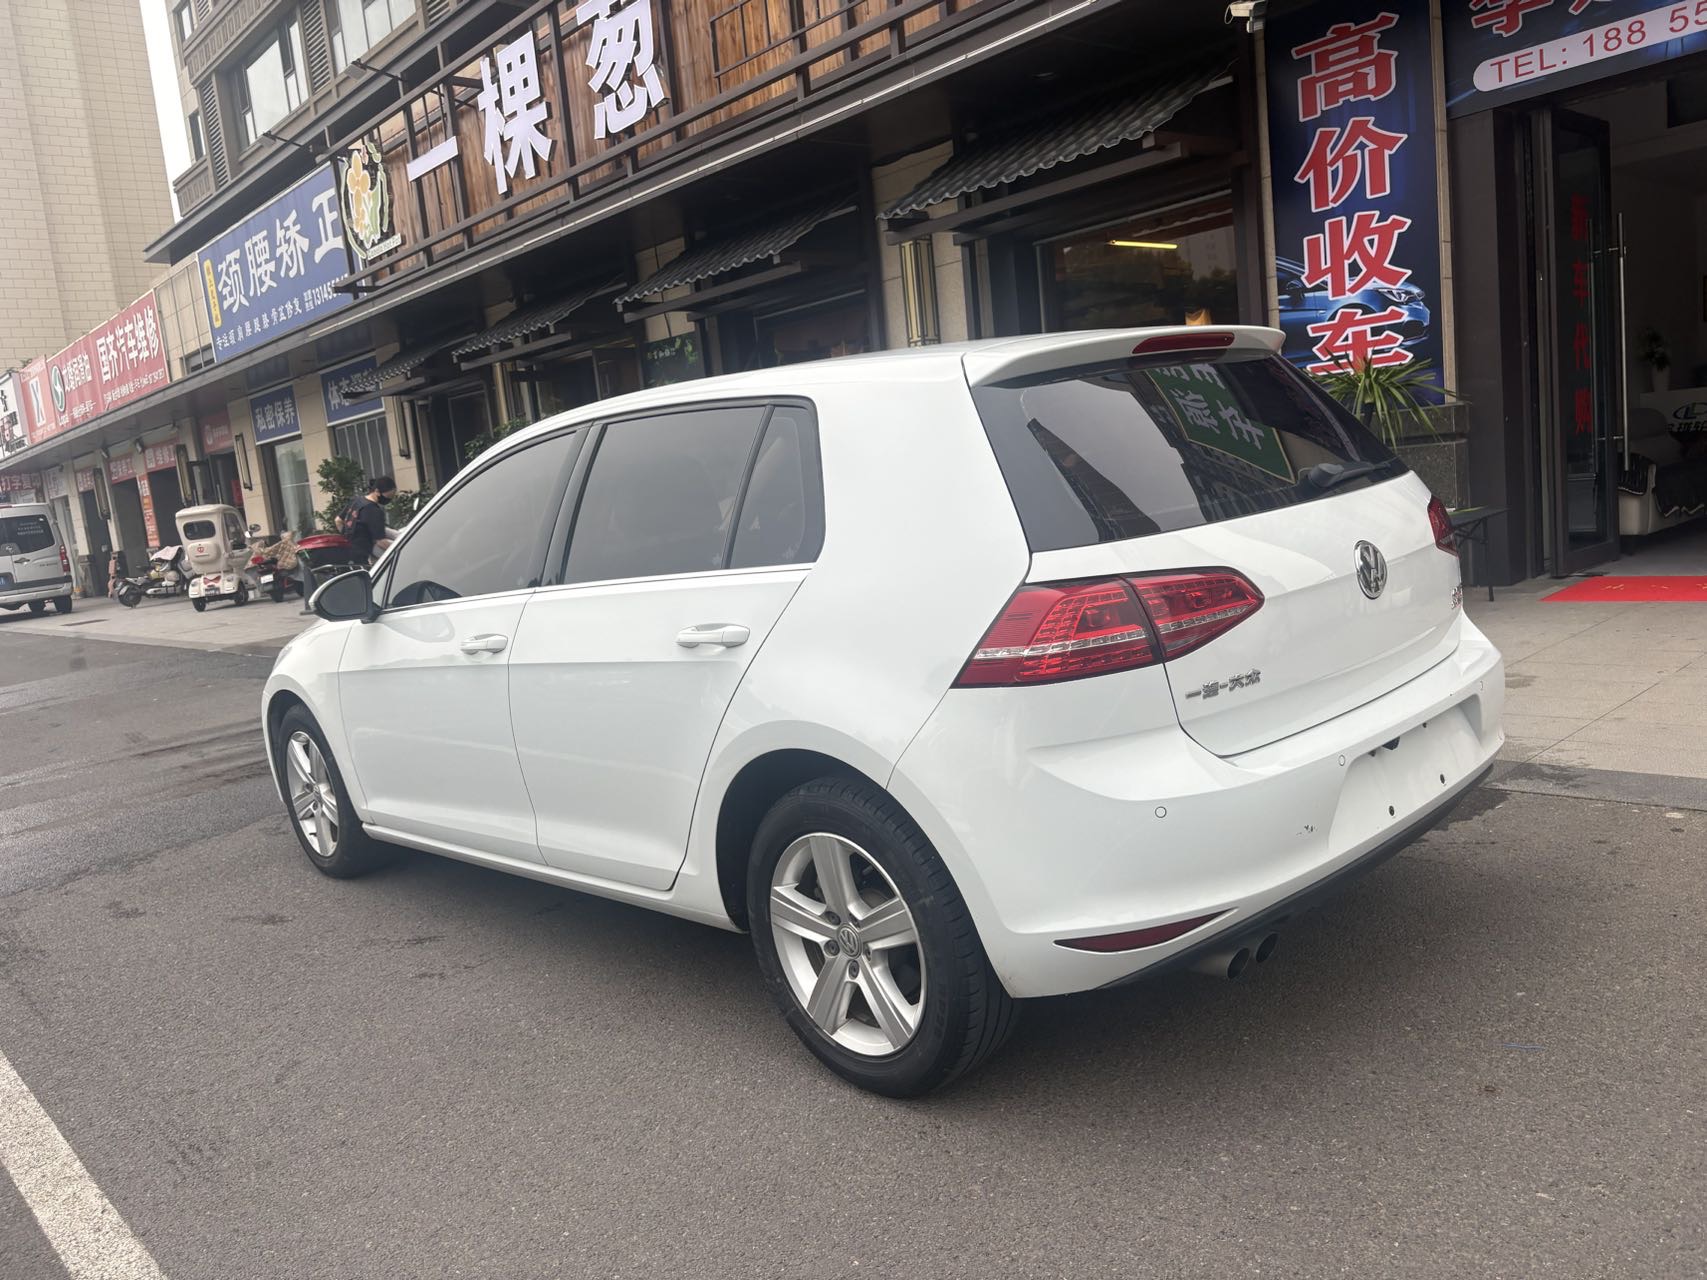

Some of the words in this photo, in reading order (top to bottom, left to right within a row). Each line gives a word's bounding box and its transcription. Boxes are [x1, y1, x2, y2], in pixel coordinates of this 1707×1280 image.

[407, 0, 669, 194] 一棵葱
[1490, 47, 1568, 83] TEL:
[1583, 20, 1646, 57] 188
[217, 187, 344, 314] 颈腰矫正
[1292, 13, 1413, 376] 高价收车
[255, 396, 295, 433] 私密保养
